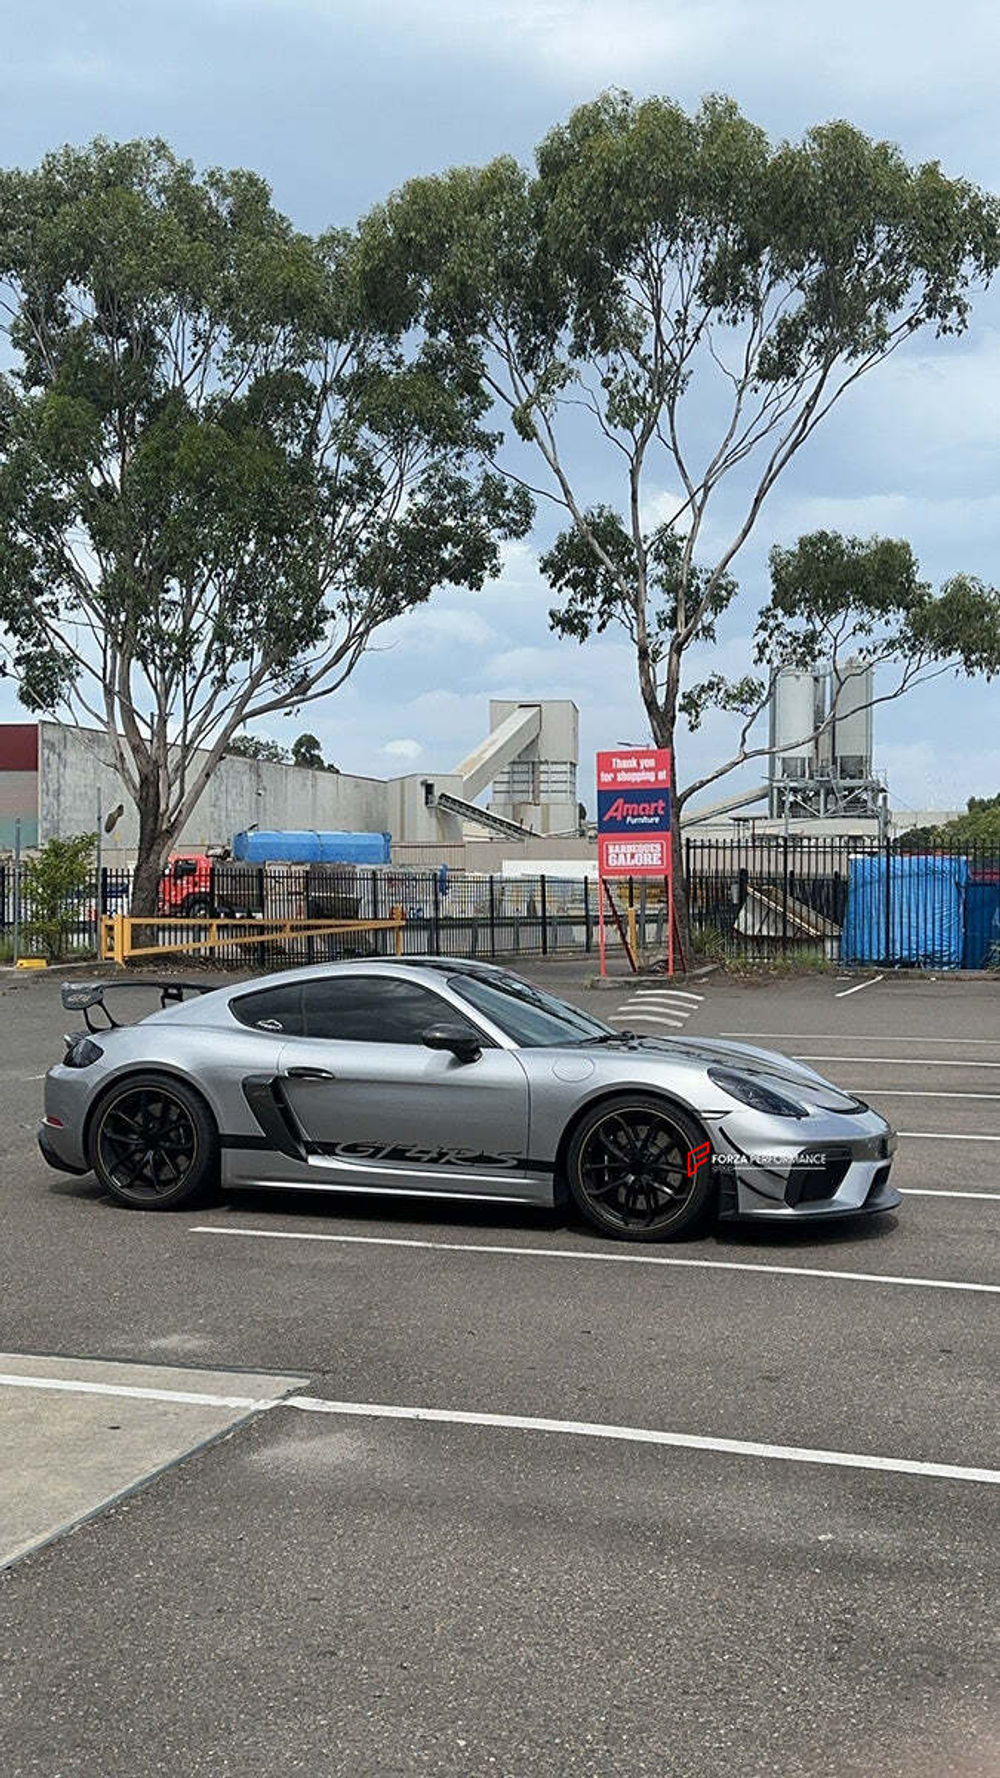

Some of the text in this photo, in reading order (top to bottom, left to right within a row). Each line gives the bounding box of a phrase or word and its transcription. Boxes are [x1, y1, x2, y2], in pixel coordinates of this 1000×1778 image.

[612, 758, 656, 770] Thank you
[600, 770, 666, 783] for shopping at
[604, 798, 665, 821] Amart
[626, 816, 659, 824] Furniture
[608, 854, 661, 866] GALORE
